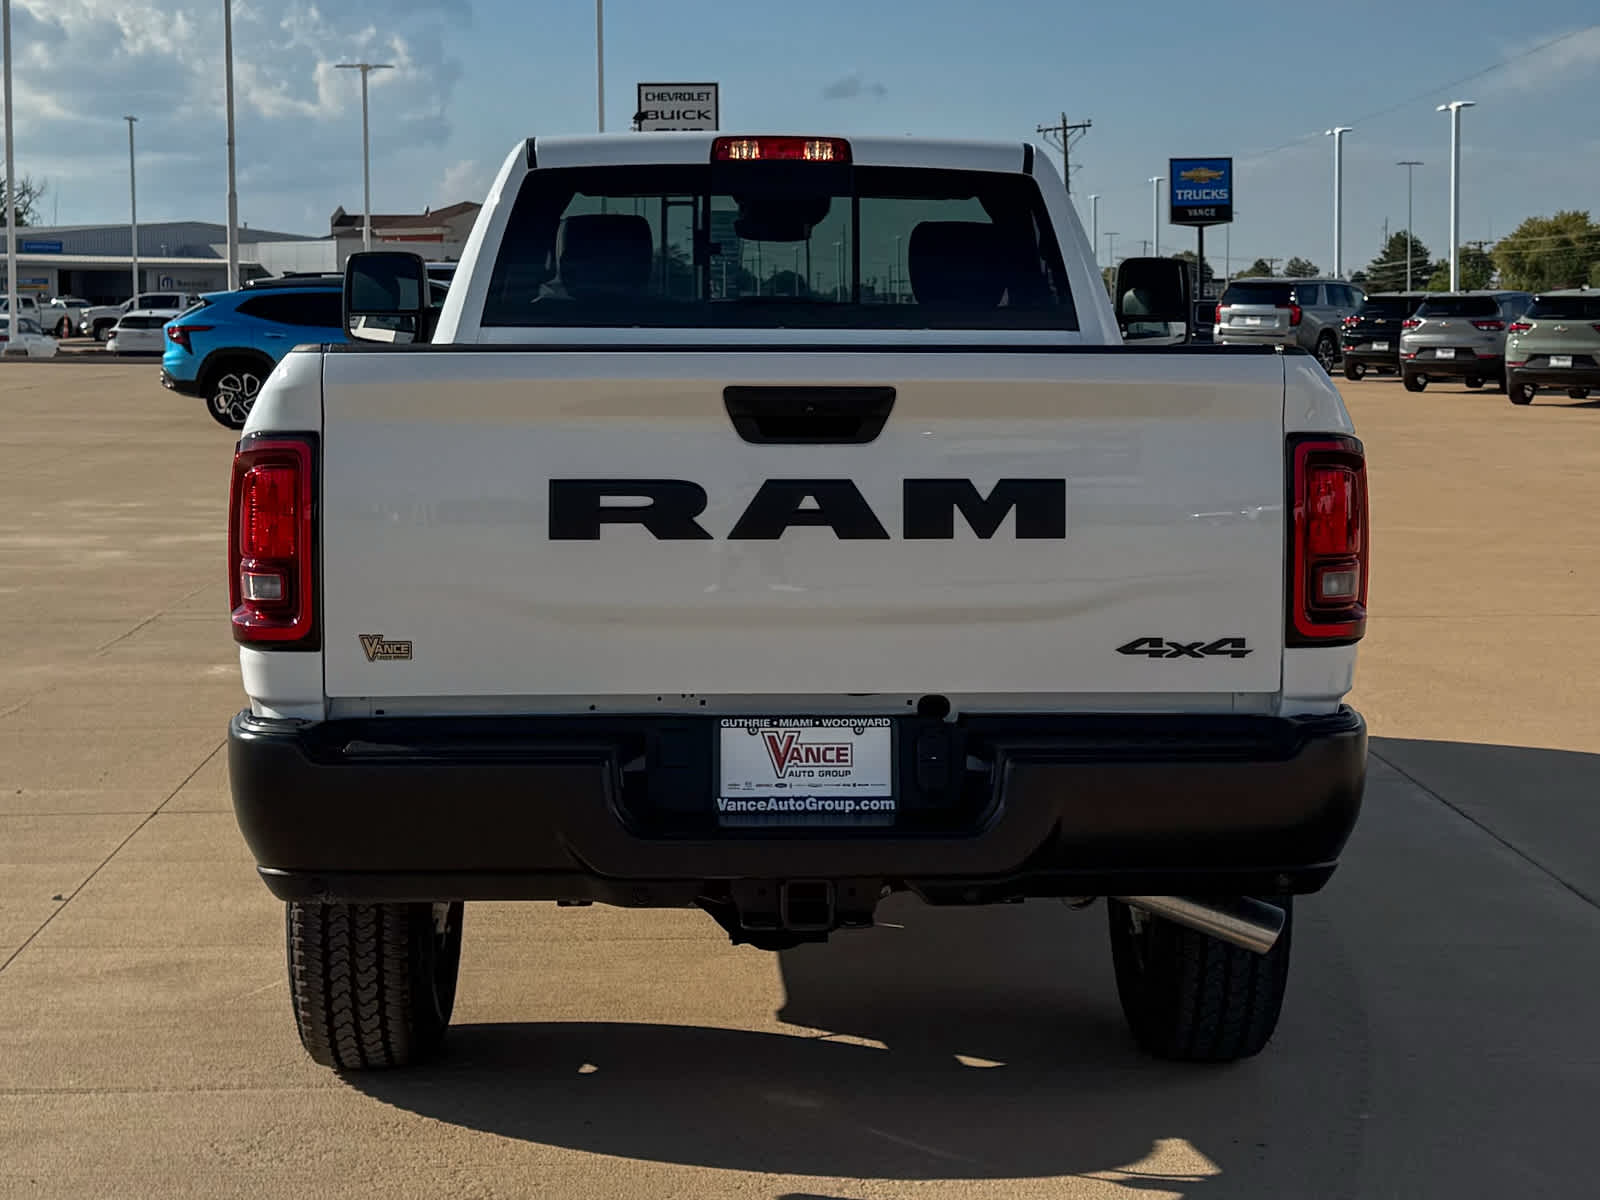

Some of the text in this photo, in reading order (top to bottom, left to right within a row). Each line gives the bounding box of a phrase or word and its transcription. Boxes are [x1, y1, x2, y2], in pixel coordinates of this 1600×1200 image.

[645, 92, 712, 101] CHEVROLET
[646, 110, 712, 120] BUICK
[1176, 189, 1229, 200] TRUCKS
[1187, 208, 1216, 216] VANCE
[549, 479, 1066, 540] RAM
[359, 635, 412, 661] VANCE
[1115, 637, 1254, 658] 4x4
[720, 718, 891, 728] GUTHRIE MIAMI WOODWARD
[762, 732, 852, 777] VANCE
[788, 770, 851, 778] AUTO GROUP
[717, 798, 895, 812] VanceAutoGroup.com
